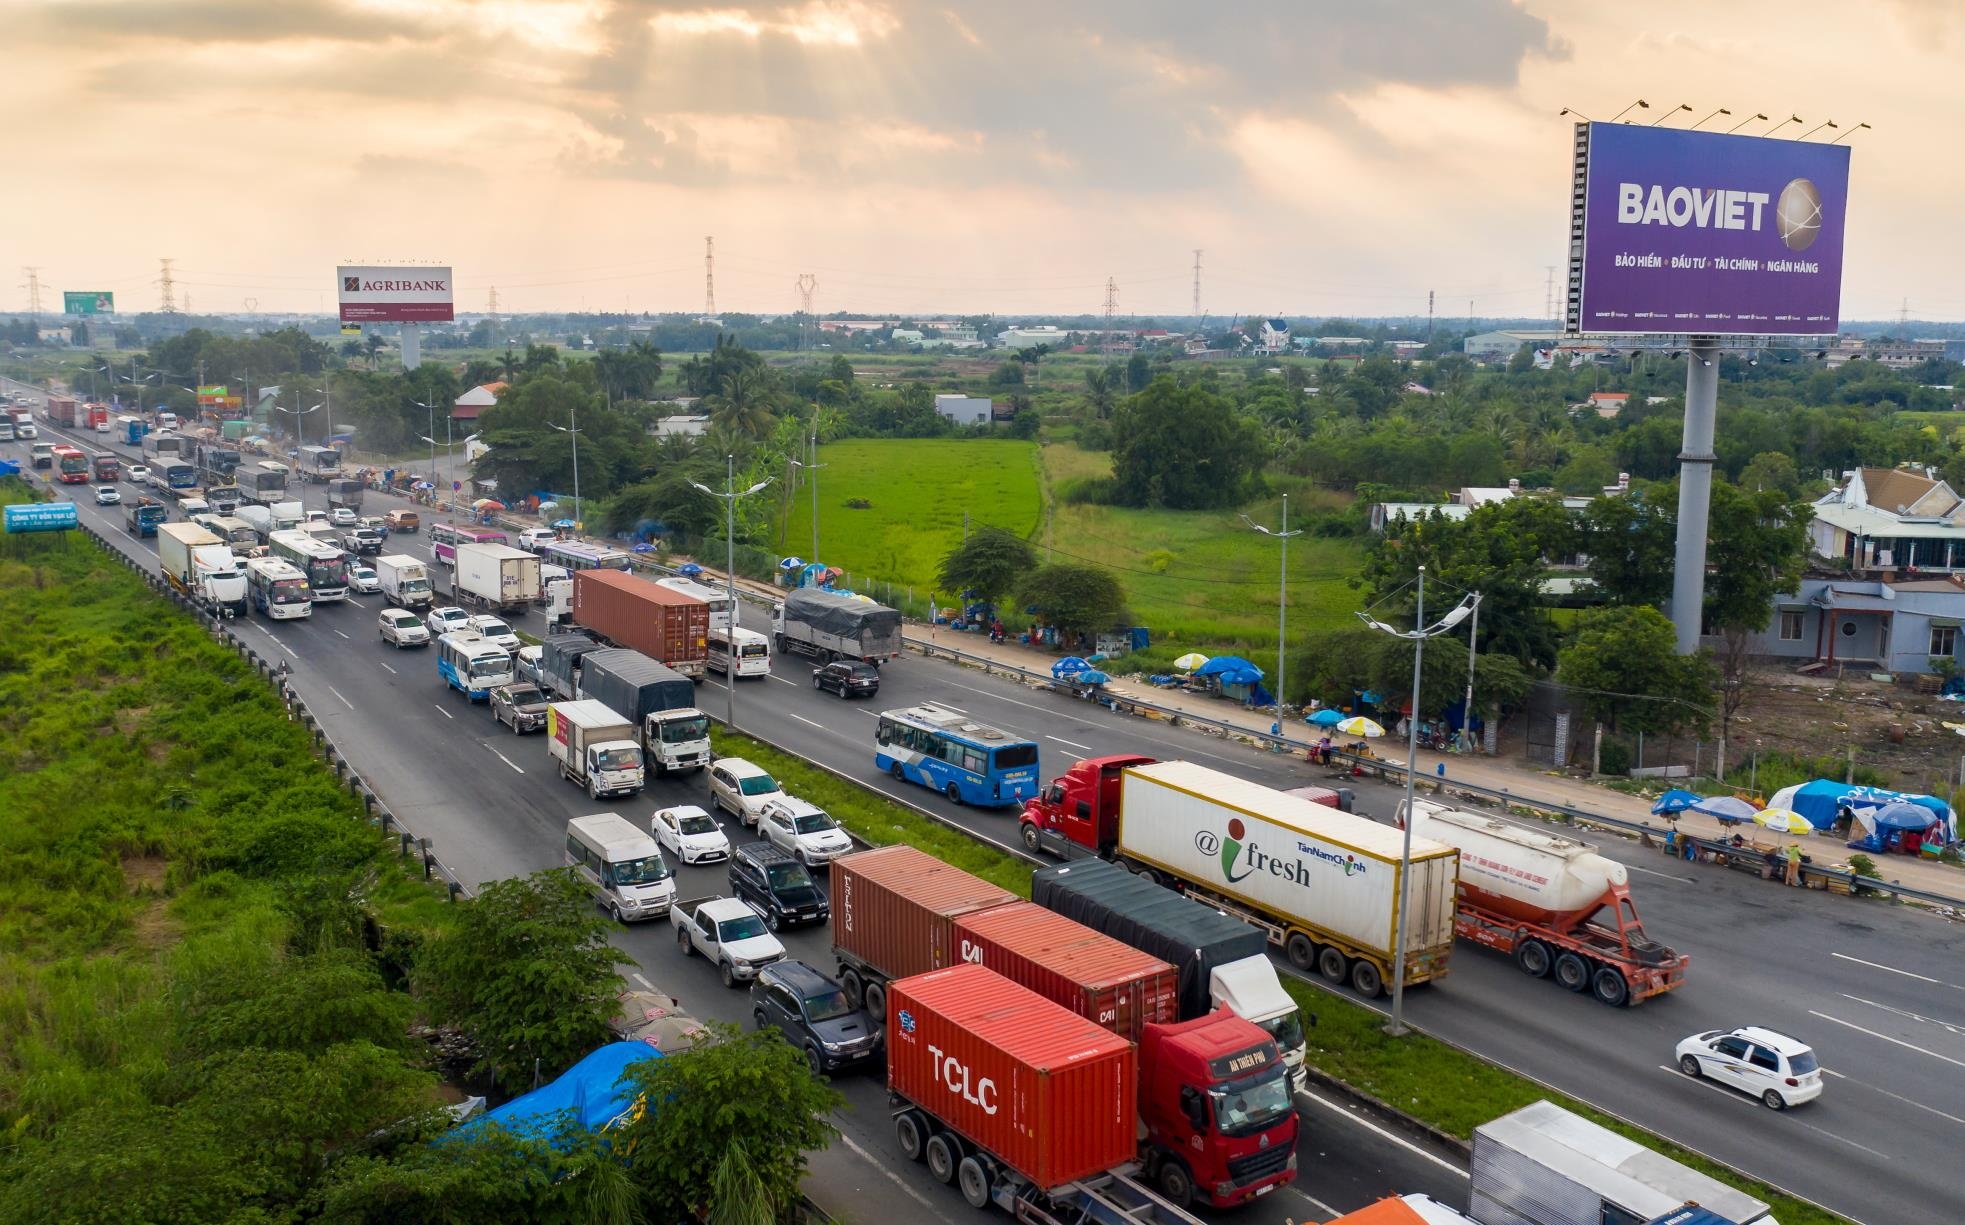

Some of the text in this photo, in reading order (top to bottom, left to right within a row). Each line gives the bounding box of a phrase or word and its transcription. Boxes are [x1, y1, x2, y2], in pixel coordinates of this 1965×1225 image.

[1618, 182, 1769, 231] BAOVIET
[1615, 252, 1636, 267] BẢO
[1714, 256, 1728, 270] TÀI
[1729, 257, 1758, 271] CHÍNH
[1767, 260, 1793, 273] NGÂN
[1793, 260, 1819, 274] HÀNG
[362, 280, 447, 291] AGRIBANK
[961, 940, 983, 967] CAI
[1100, 1009, 1115, 1023] CAI
[928, 1044, 998, 1115] TCLC
